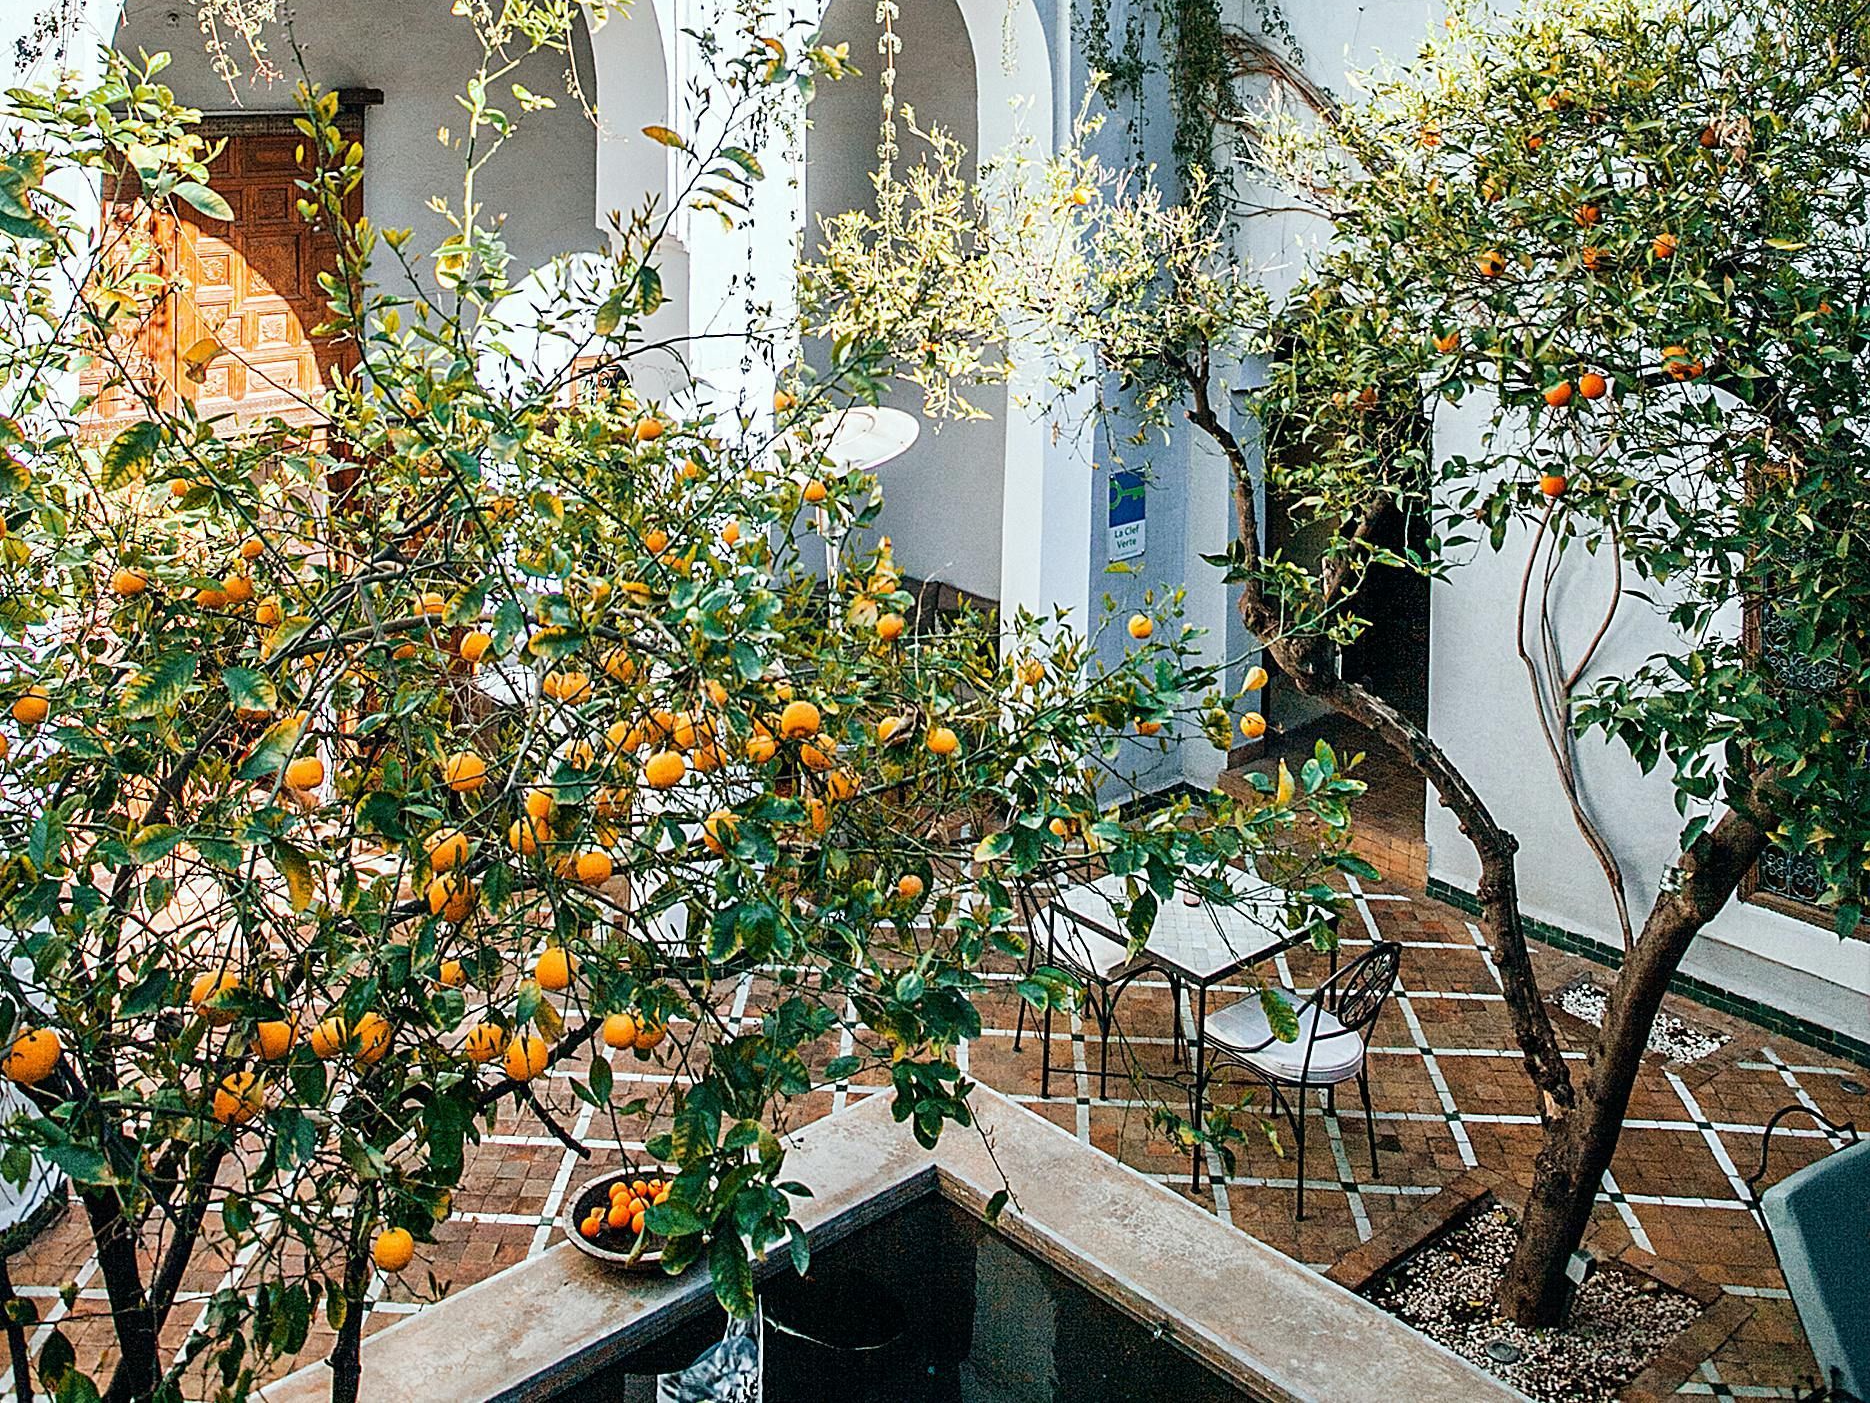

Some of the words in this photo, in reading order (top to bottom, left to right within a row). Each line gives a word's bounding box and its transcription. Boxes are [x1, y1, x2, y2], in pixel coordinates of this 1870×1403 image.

[1114, 530, 1123, 538] La
[1125, 524, 1139, 535] Clef
[1116, 538, 1137, 549] Verte
